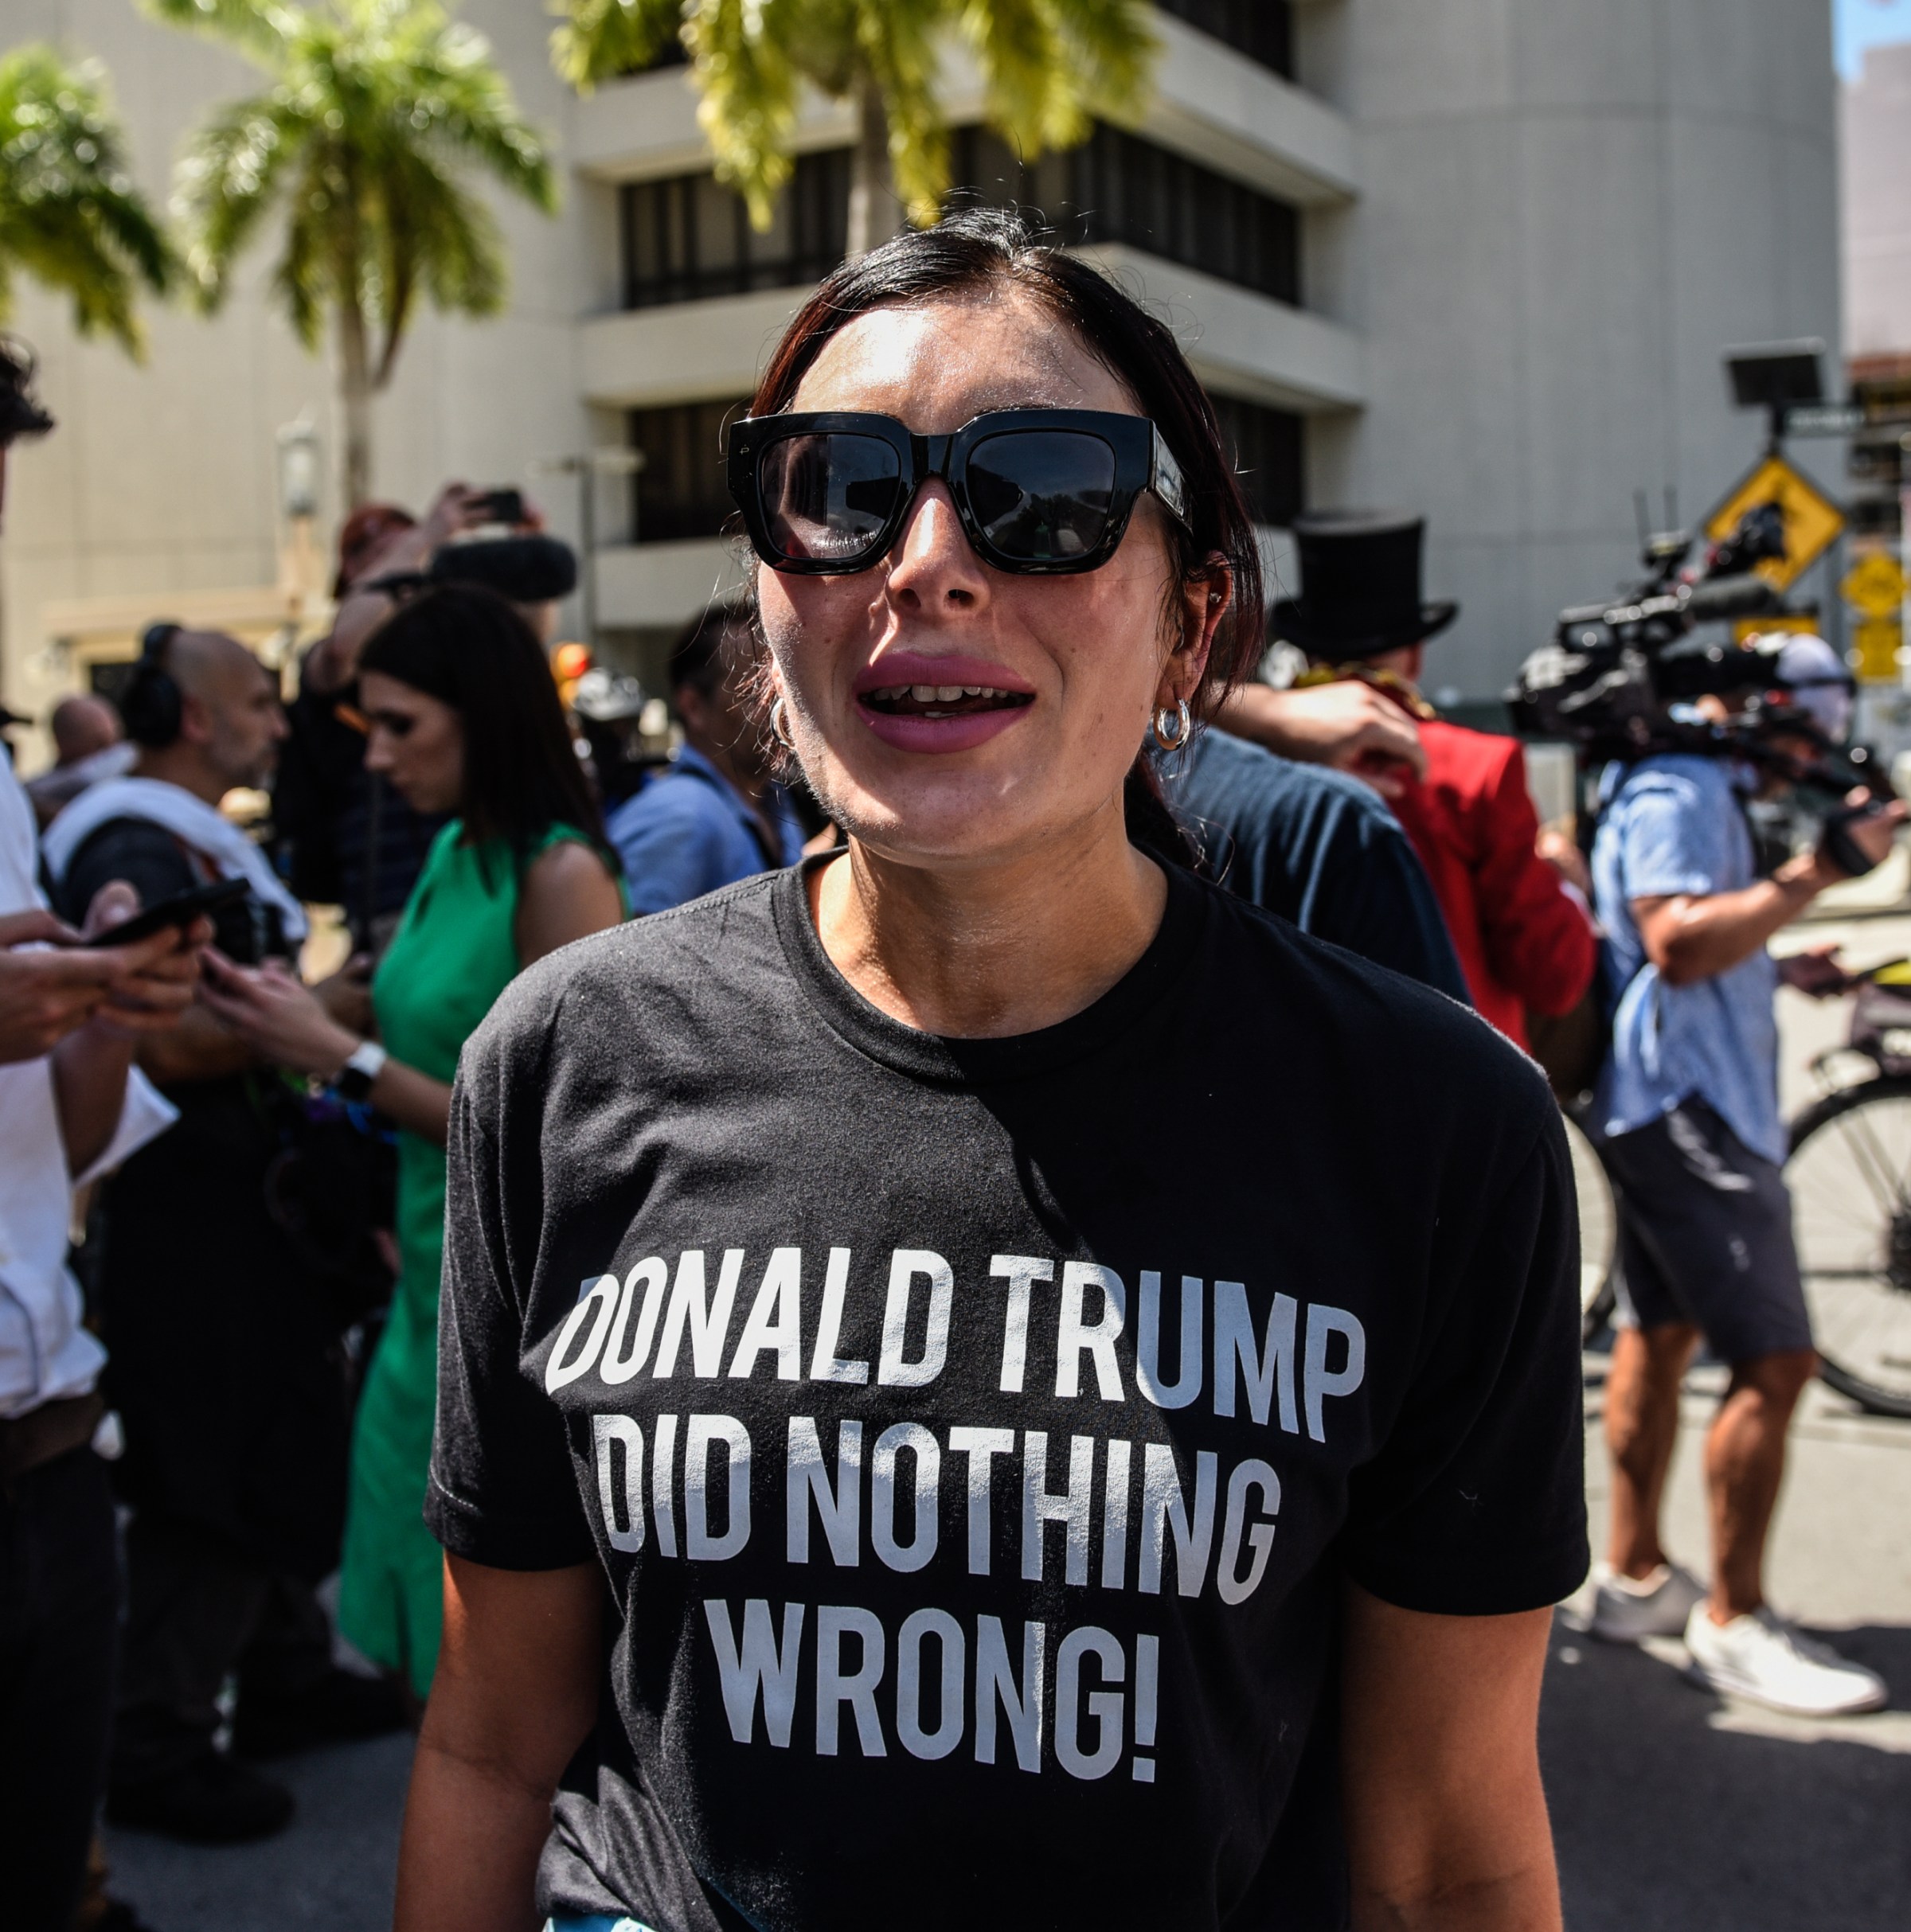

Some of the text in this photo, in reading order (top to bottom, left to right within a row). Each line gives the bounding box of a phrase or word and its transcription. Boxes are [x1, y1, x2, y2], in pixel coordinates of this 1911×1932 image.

[545, 1247, 1366, 1443] DONALD TRUMP
[592, 1413, 1281, 1606] DID NOTHING
[703, 1598, 1159, 1783] WRONG!
